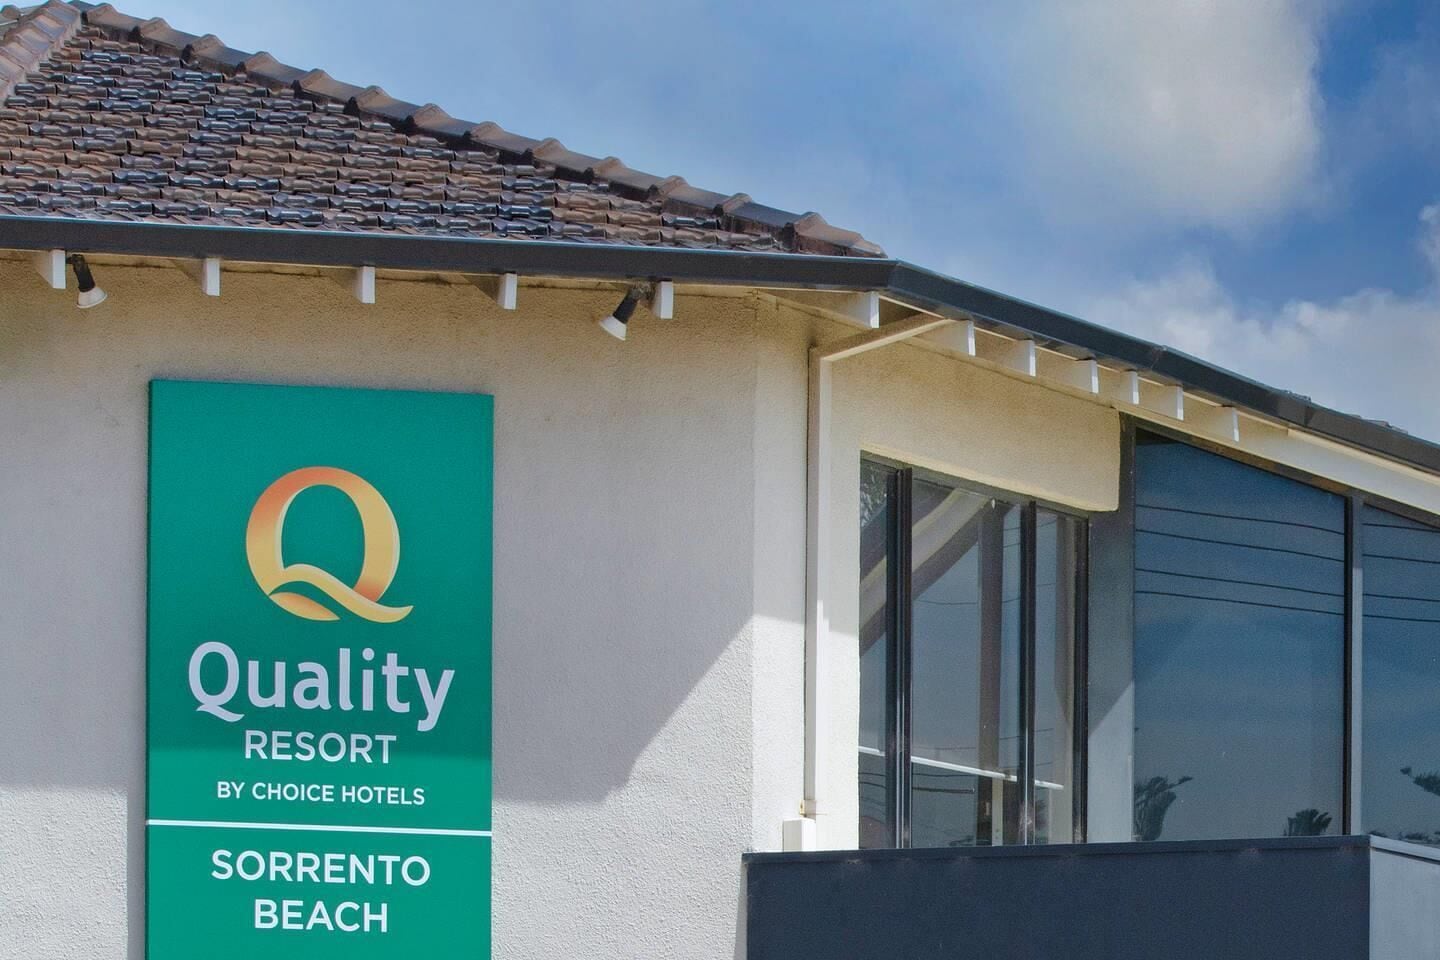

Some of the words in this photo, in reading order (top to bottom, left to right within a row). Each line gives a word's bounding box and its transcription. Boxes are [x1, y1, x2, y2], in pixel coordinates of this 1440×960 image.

[188, 641, 455, 732] Quality
[245, 731, 397, 764] RESORT
[217, 781, 245, 799] BY
[251, 783, 335, 803] CHOICE
[341, 786, 425, 806] HOTELS
[211, 849, 431, 887] SORRENTO
[254, 899, 388, 933] BEACH
